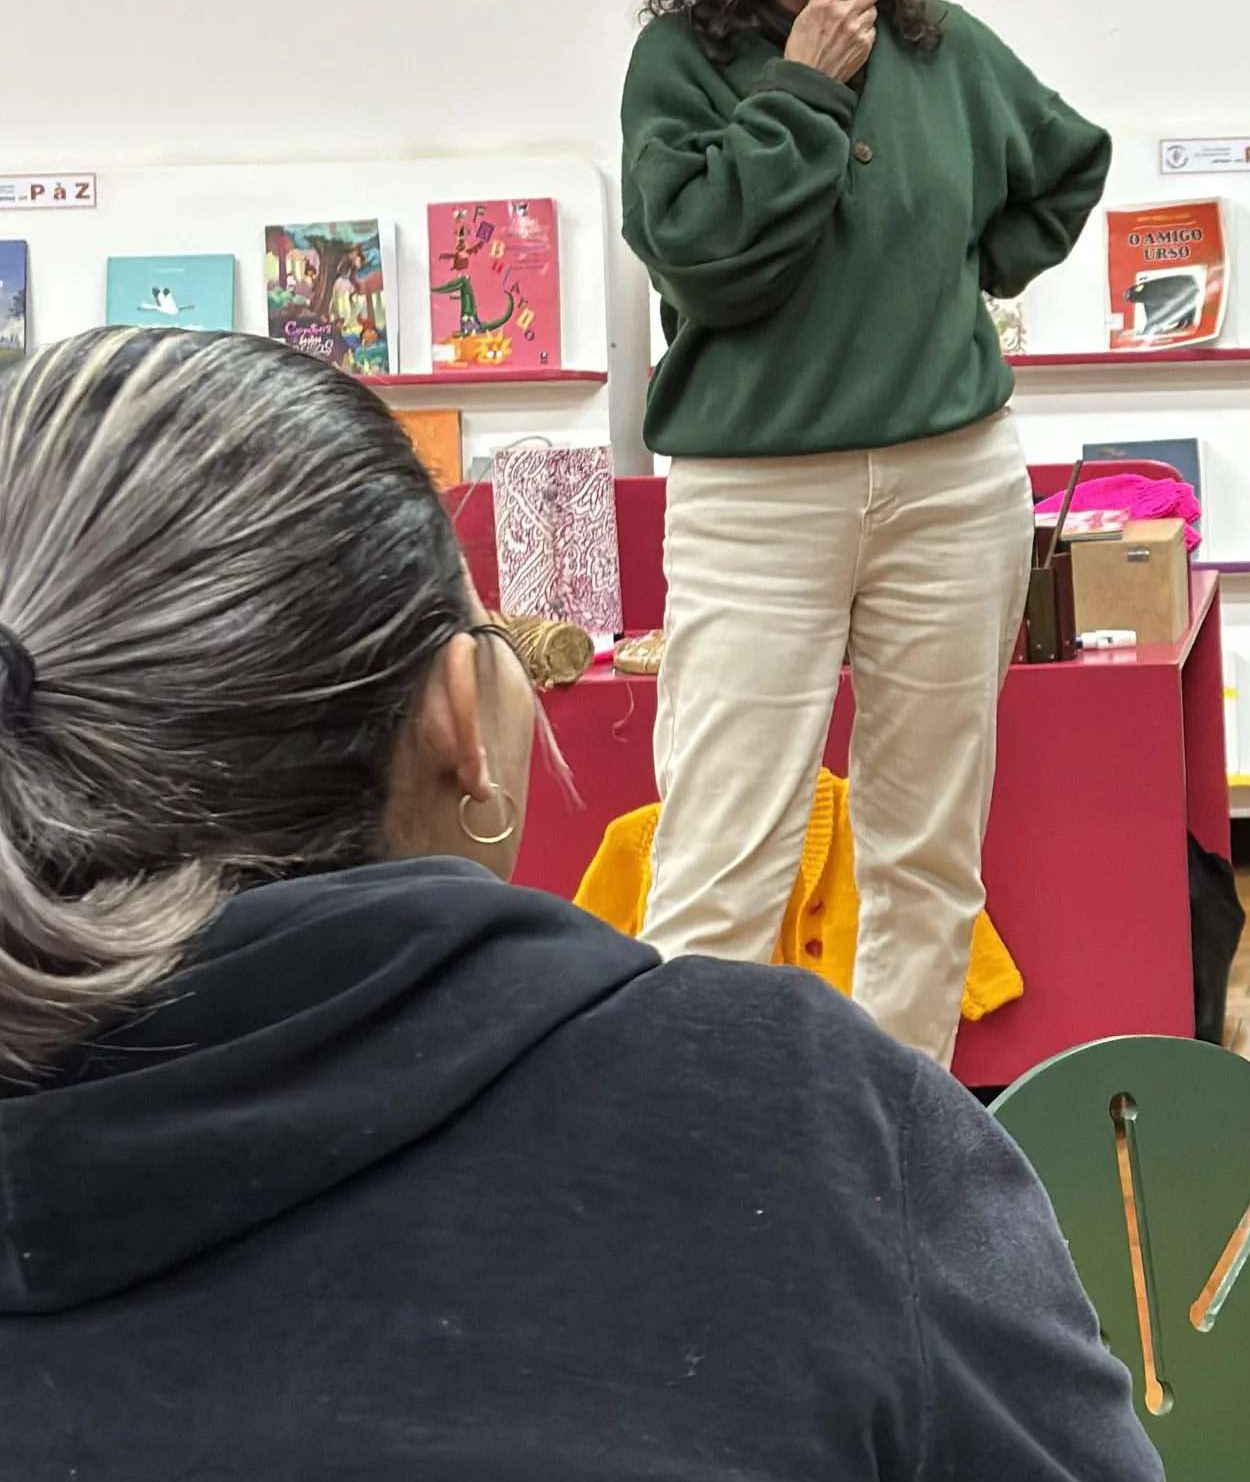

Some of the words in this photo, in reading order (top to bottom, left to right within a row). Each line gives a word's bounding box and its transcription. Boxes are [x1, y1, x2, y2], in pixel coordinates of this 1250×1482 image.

[30, 183, 45, 201] P
[75, 182, 91, 199] Z
[1128, 233, 1141, 246] O
[1144, 228, 1203, 245] AMIGO
[1144, 246, 1190, 260] URSO
